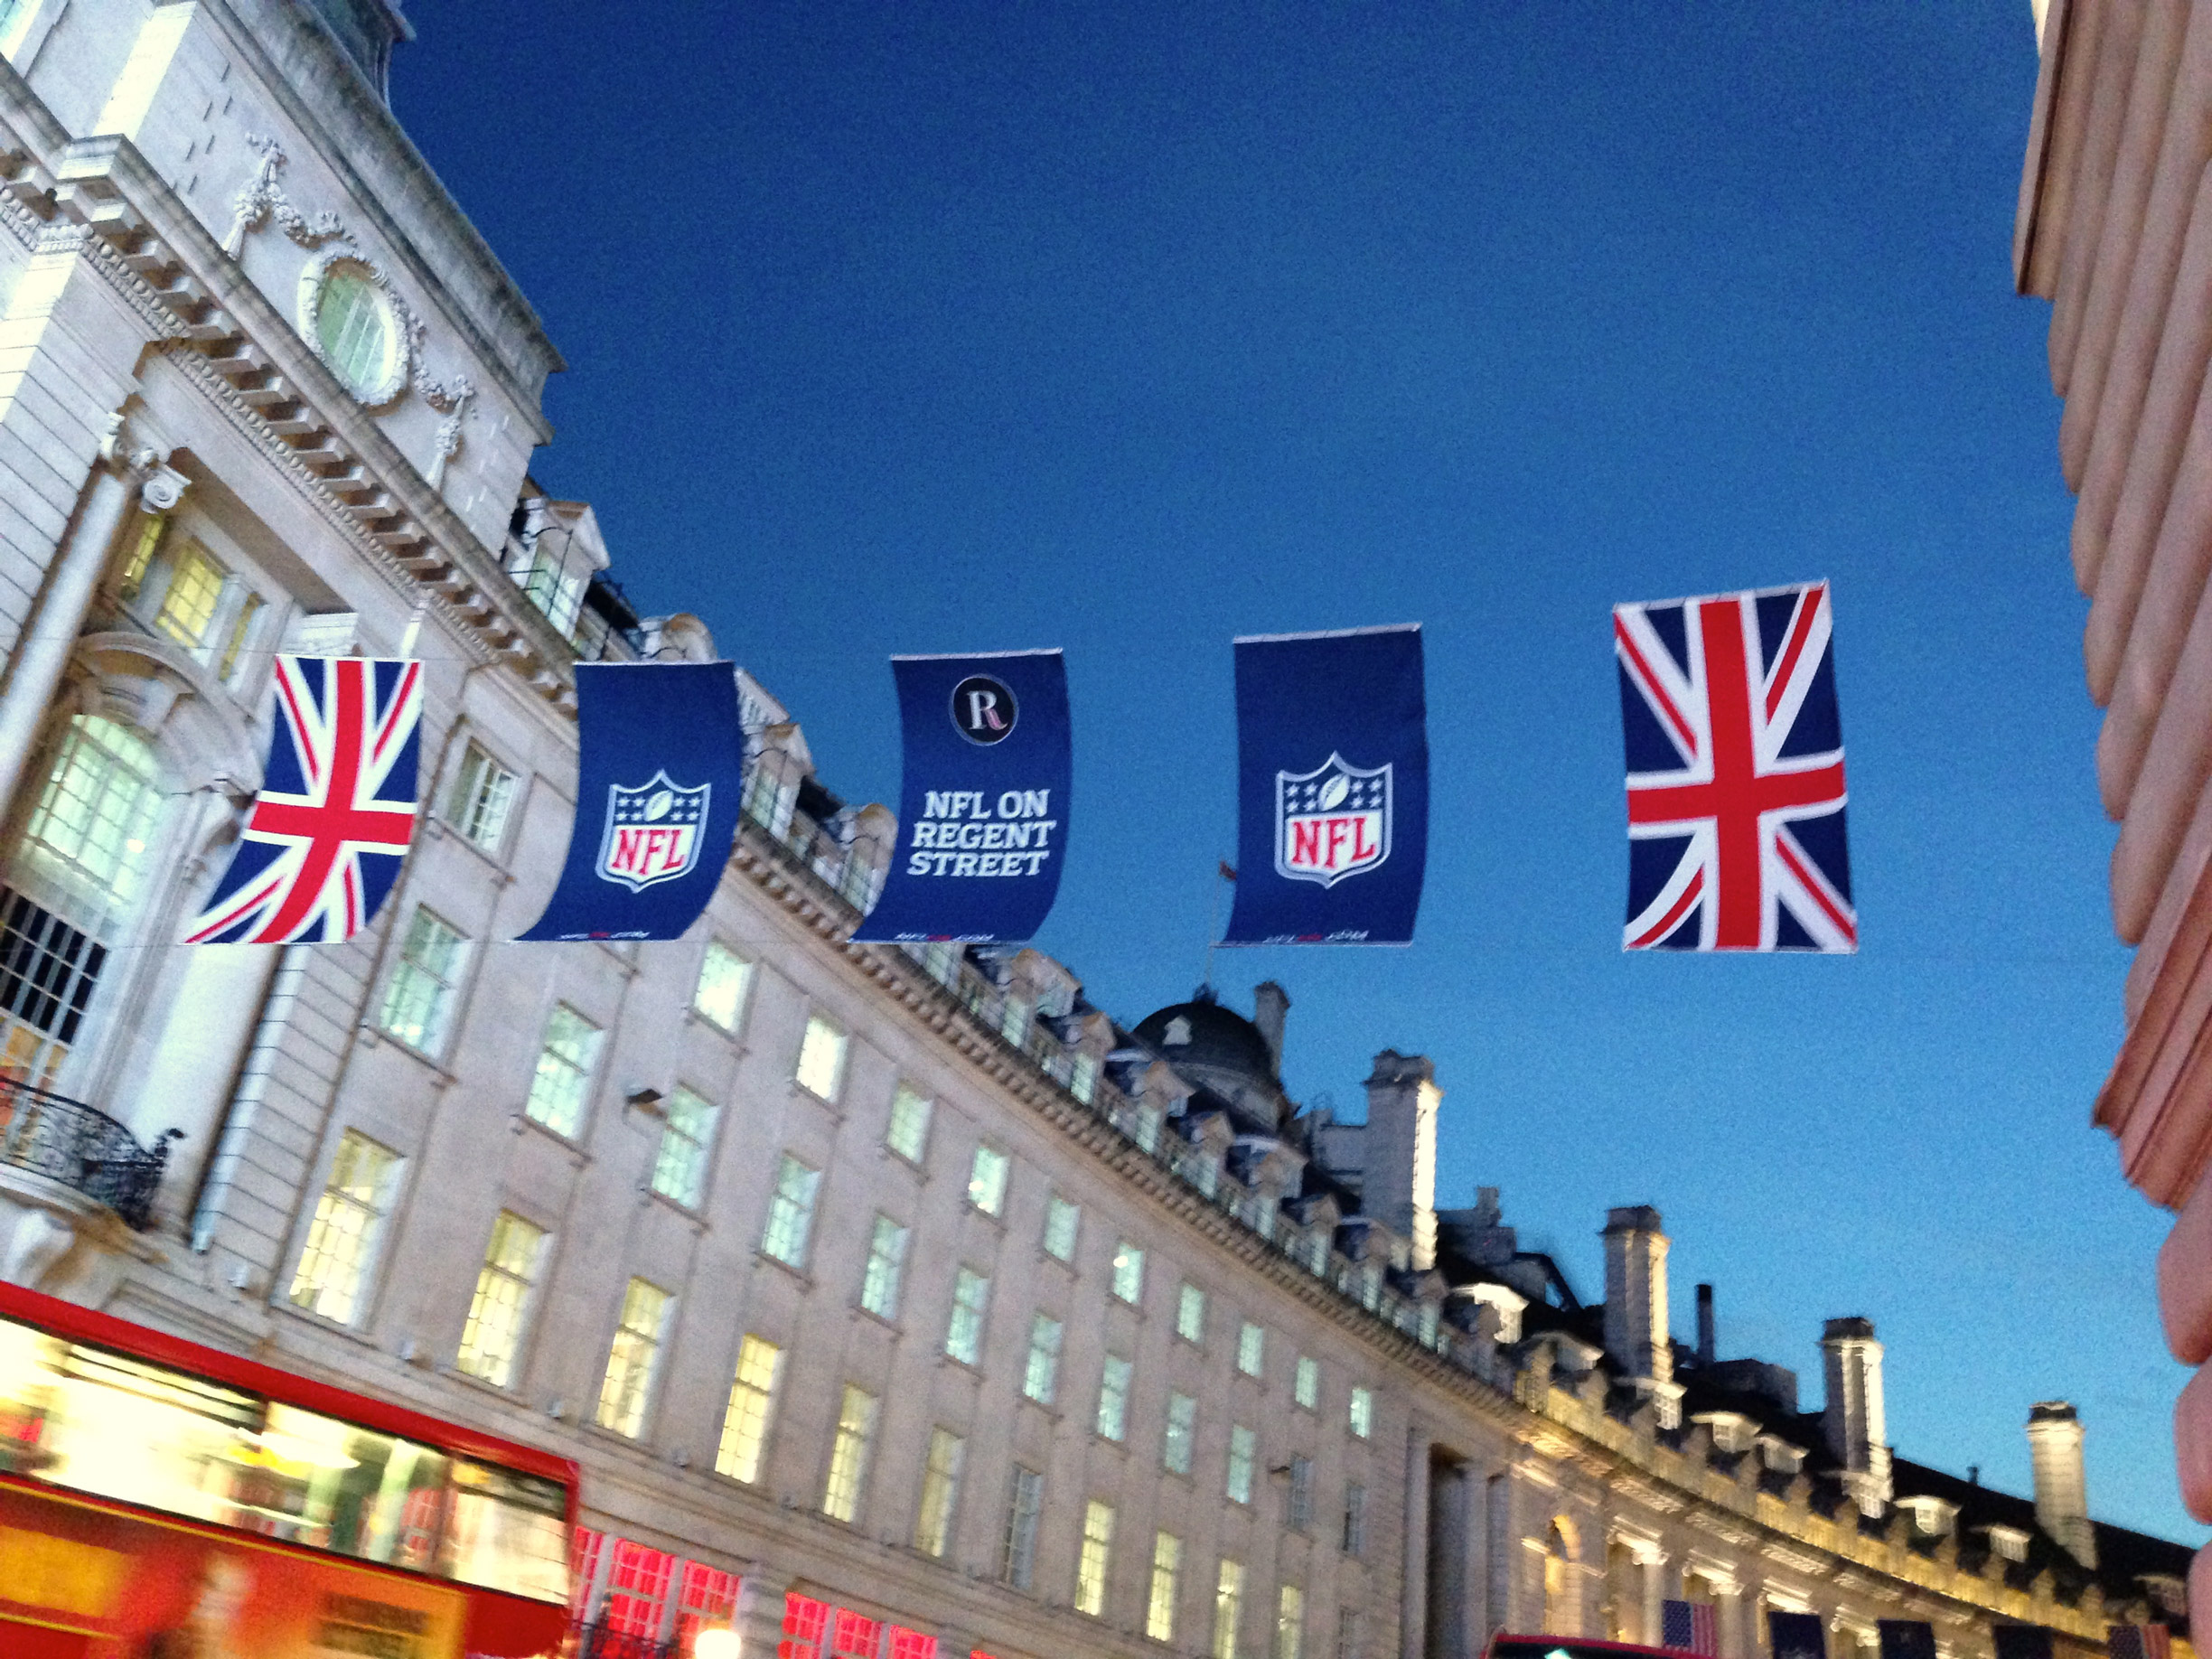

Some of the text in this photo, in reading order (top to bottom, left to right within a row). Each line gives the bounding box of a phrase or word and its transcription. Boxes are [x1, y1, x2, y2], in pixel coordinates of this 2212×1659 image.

[967, 690, 1008, 730] R
[923, 789, 1051, 819] NFL ON
[911, 820, 1056, 849] REGENT
[1291, 816, 1376, 868] NFL
[612, 829, 685, 876] NFL
[906, 850, 1050, 876] STREET
